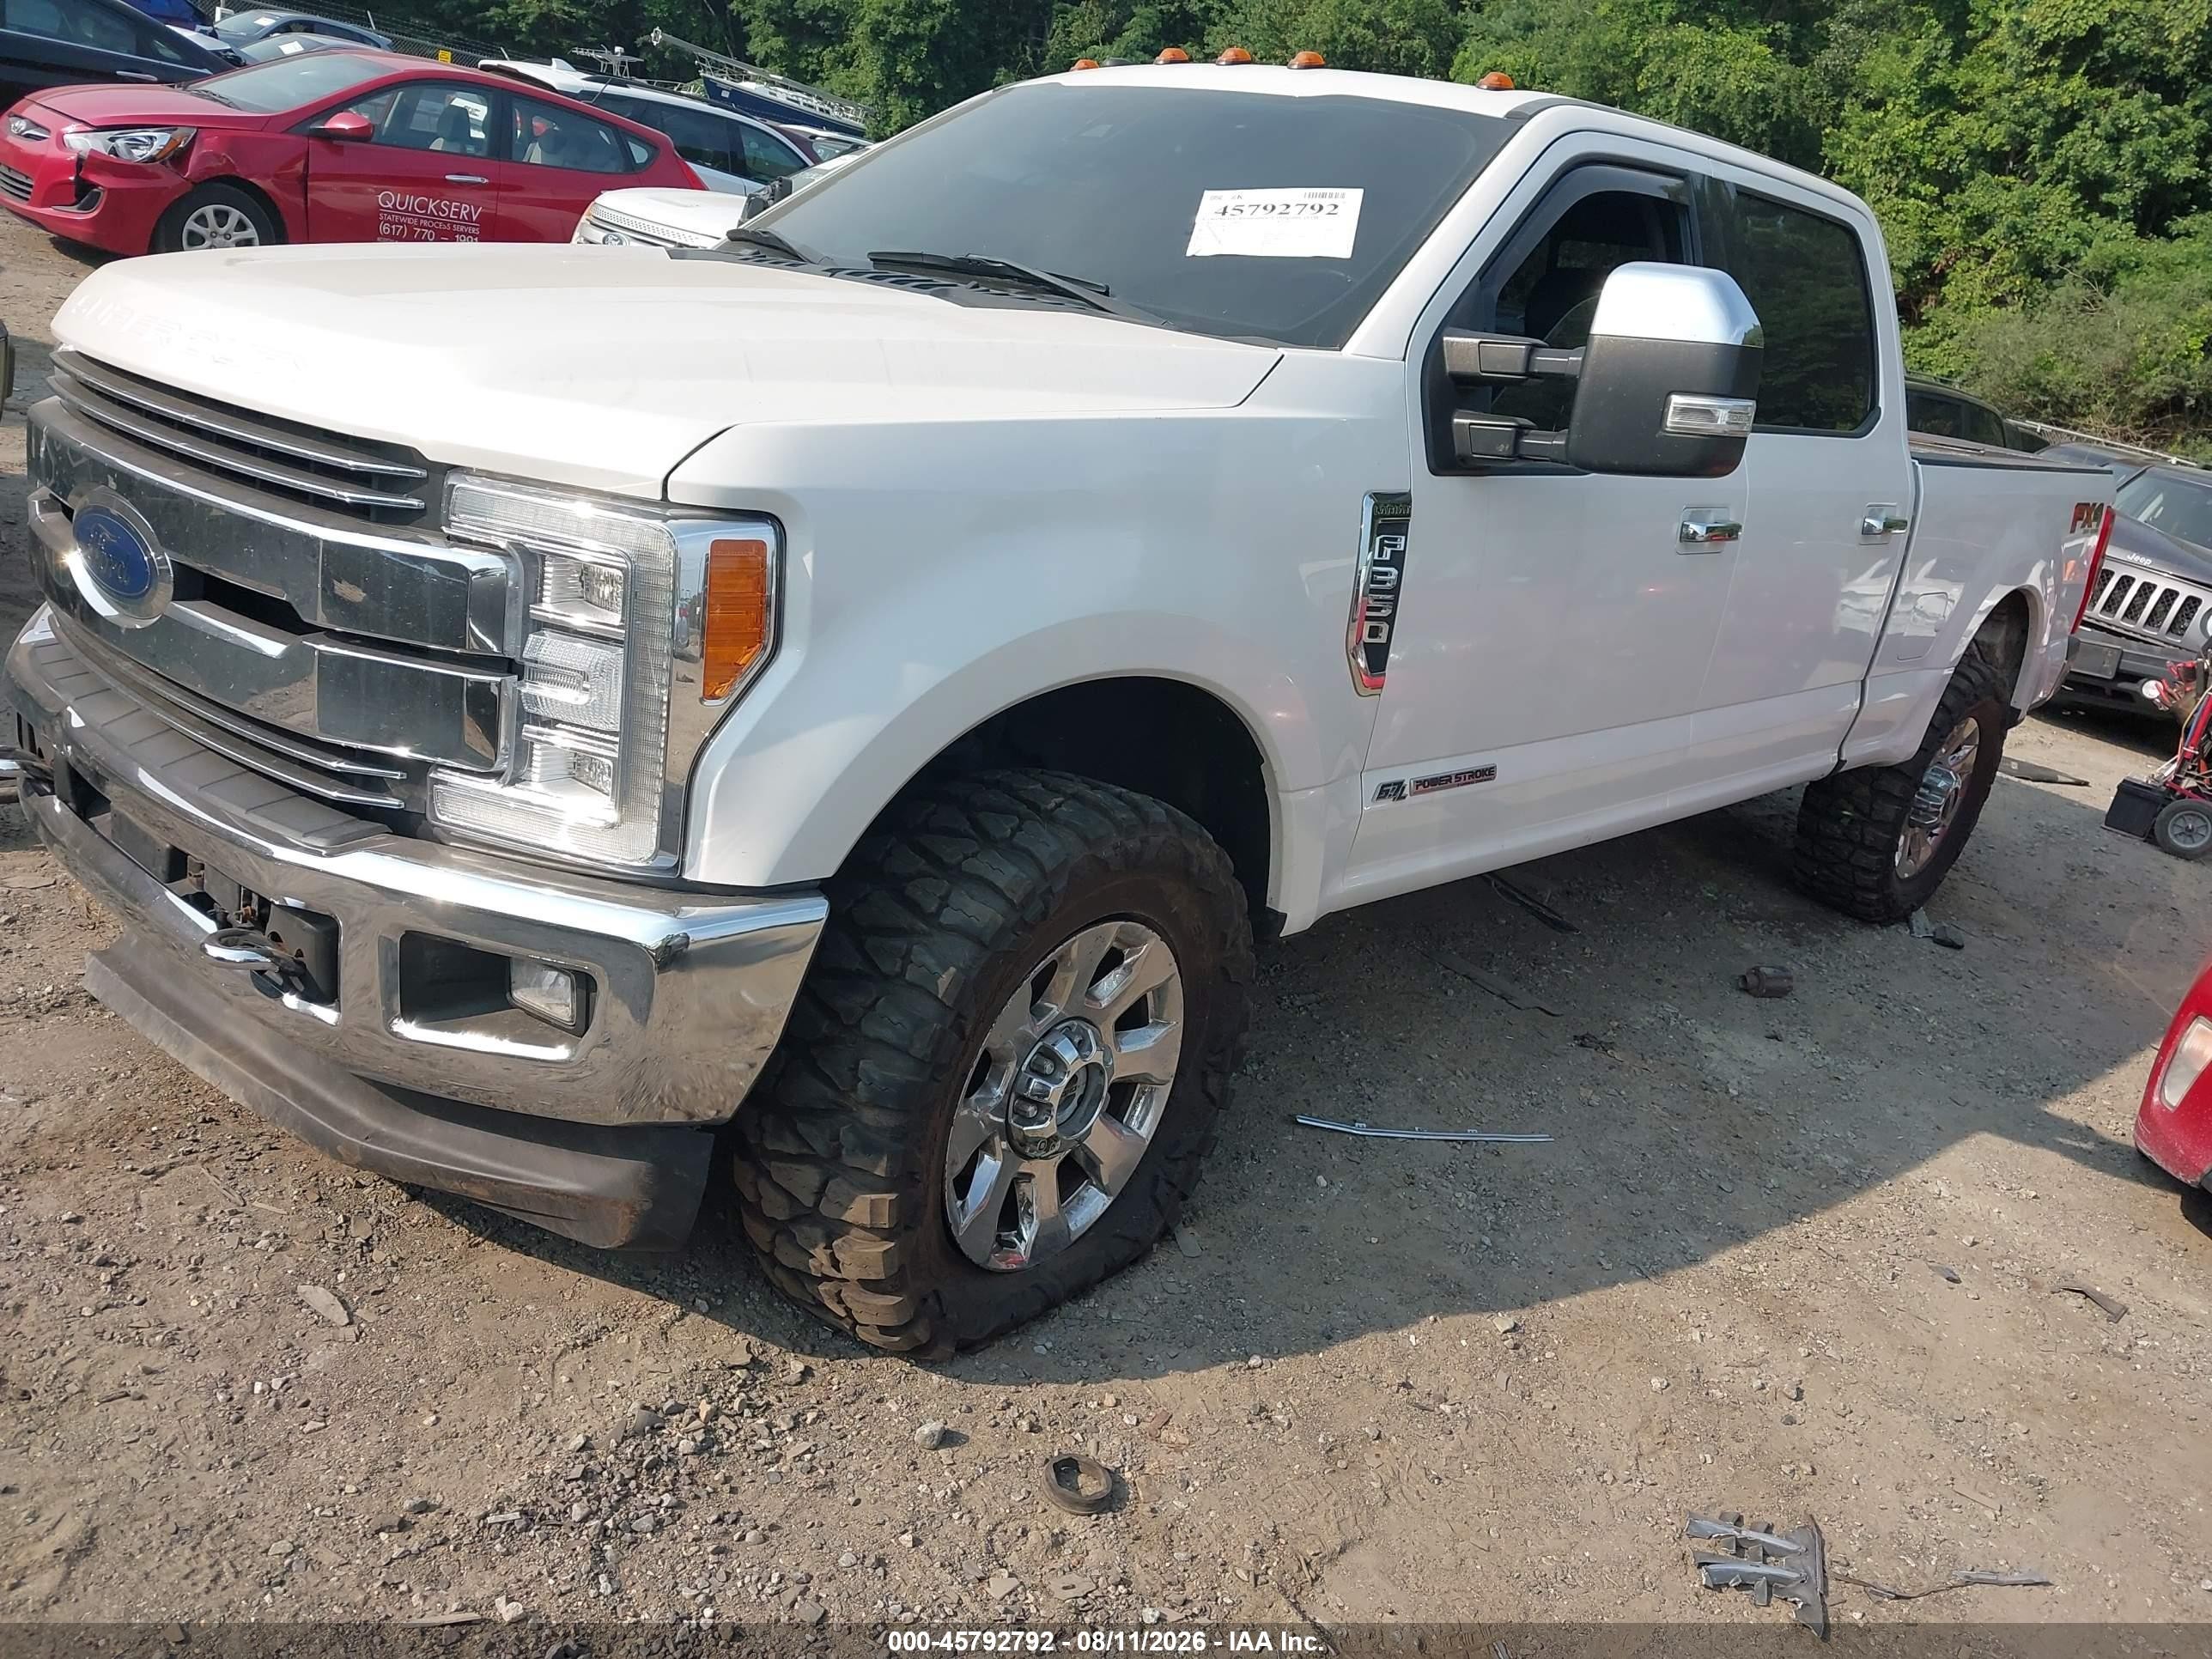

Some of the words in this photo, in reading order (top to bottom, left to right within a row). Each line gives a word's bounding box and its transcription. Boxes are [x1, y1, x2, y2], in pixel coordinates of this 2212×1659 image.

[378, 191, 483, 222] QUICKSERV
[1214, 204, 1340, 216] 45792792
[379, 213, 418, 226] STATEWIDE
[420, 219, 451, 231] PROCESS
[453, 224, 480, 234] SERVERS
[379, 221, 407, 239] (617)
[413, 227, 435, 241] 770
[2069, 502, 2105, 534] FX4
[2126, 552, 2153, 566] Jeep
[1415, 775, 1453, 791] POWER
[1454, 767, 1495, 783] STROKE
